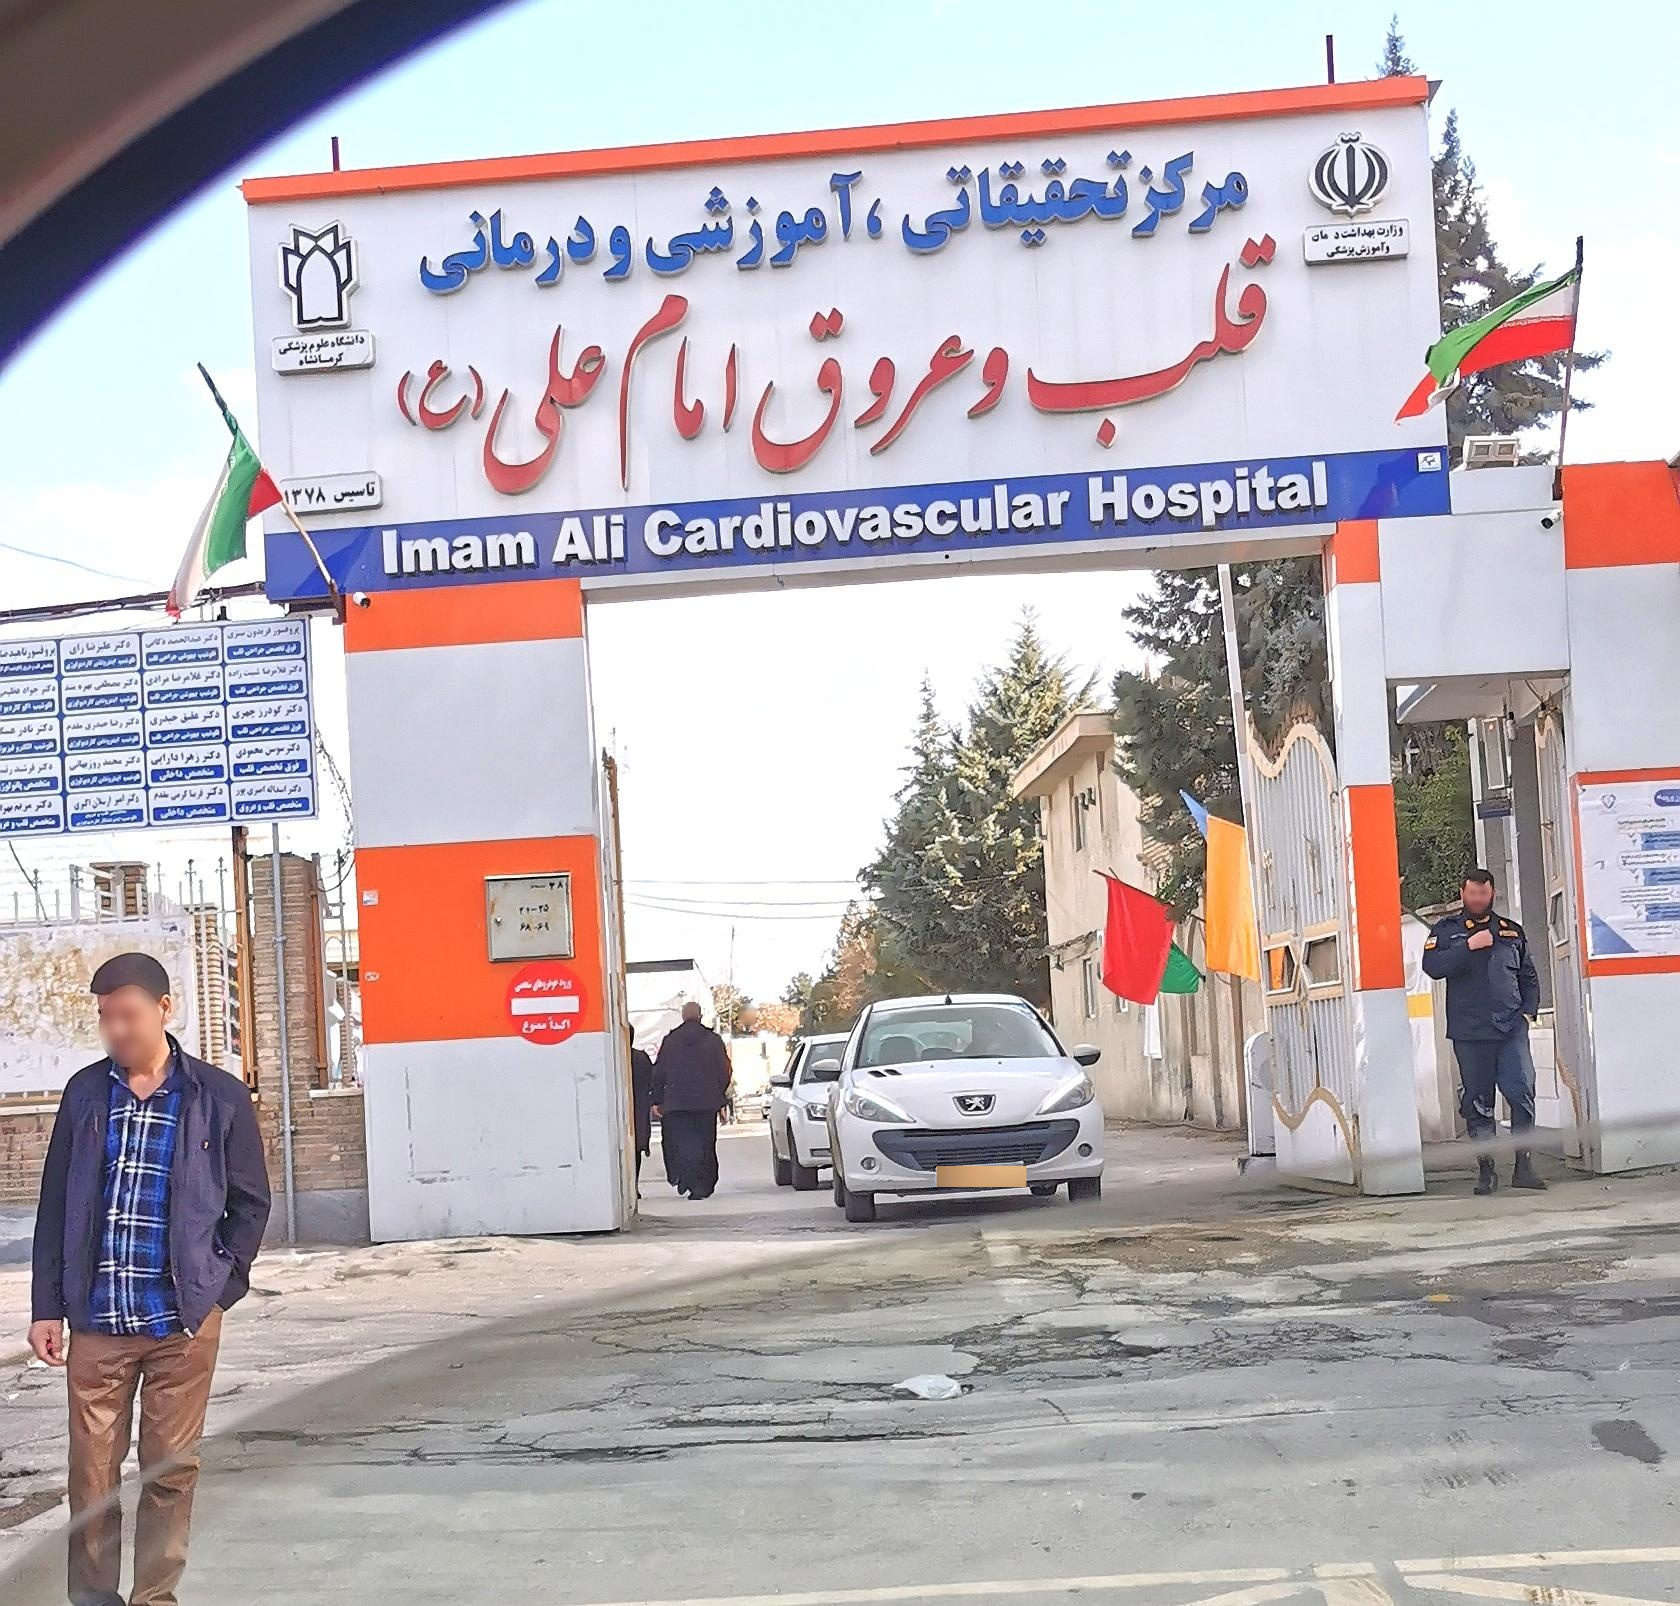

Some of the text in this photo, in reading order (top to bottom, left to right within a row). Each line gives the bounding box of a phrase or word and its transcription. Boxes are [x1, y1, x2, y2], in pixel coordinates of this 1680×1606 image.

[1132, 151, 1248, 238] مرکز
[646, 171, 862, 277] آموزشی
[1341, 227, 1374, 238] بهداشت
[1377, 225, 1403, 236] وزارت
[420, 207, 599, 295] درمانی
[603, 226, 633, 281] و
[310, 339, 329, 353] علوم
[330, 334, 364, 349] دانشگاه
[299, 353, 343, 368] کرمانشاه
[397, 233, 1276, 497] قلب و عروق امام علی (ع)
[334, 482, 375, 502] تاسیس
[382, 459, 1329, 575] Imam Ali Cardiovascular Hospital
[203, 634, 218, 644] دکتر
[114, 641, 130, 651] دکتر
[289, 666, 302, 674] دکتر
[204, 671, 220, 682] دکتر
[123, 679, 138, 689] دکتر
[285, 704, 302, 715] دکتر
[202, 710, 220, 722] دکتر
[125, 717, 139, 728] دکتر
[36, 723, 53, 735] دکتر
[285, 744, 300, 753] دکتر
[125, 756, 140, 766] دکتر
[202, 750, 221, 763] دکتر
[37, 763, 53, 773] دکتر
[206, 786, 223, 799] دکتر
[288, 785, 301, 795] دکتر
[35, 800, 52, 812] دکتر
